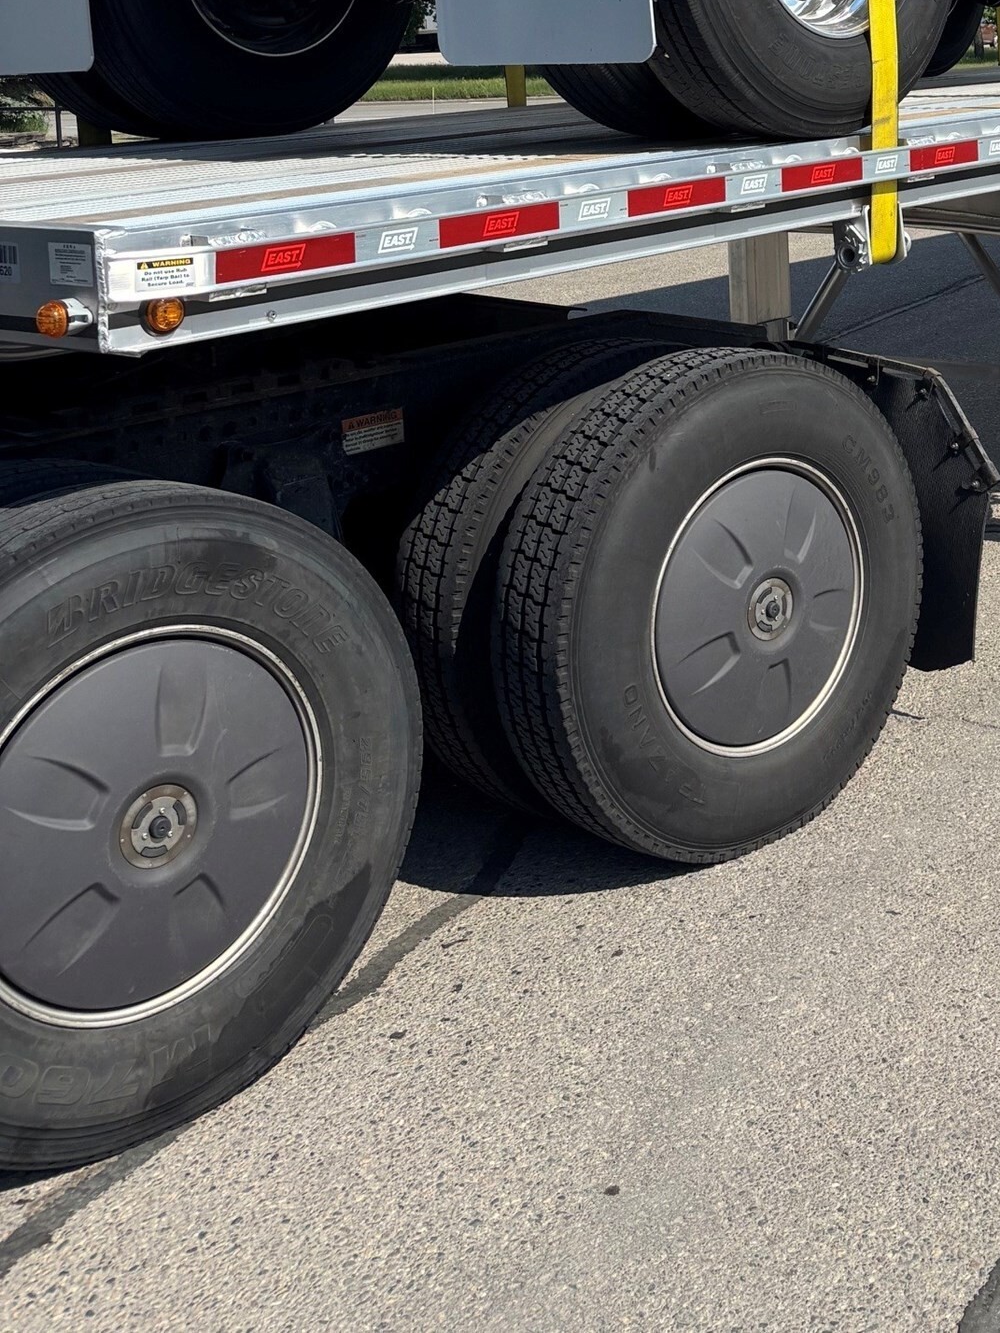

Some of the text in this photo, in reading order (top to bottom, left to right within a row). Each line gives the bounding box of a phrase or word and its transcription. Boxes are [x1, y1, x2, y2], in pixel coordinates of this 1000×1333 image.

[937, 149, 954, 160] EAST
[878, 158, 896, 170] EAST
[814, 167, 833, 180] EAST
[744, 177, 765, 191] EAST
[668, 189, 690, 203] EAST
[582, 203, 606, 218] EAST
[488, 217, 514, 232] EAST
[383, 233, 413, 248] EAST
[152, 258, 191, 268] WARNING
[267, 250, 299, 266] EAST
[46, 561, 351, 654] BRIDGESTONE
